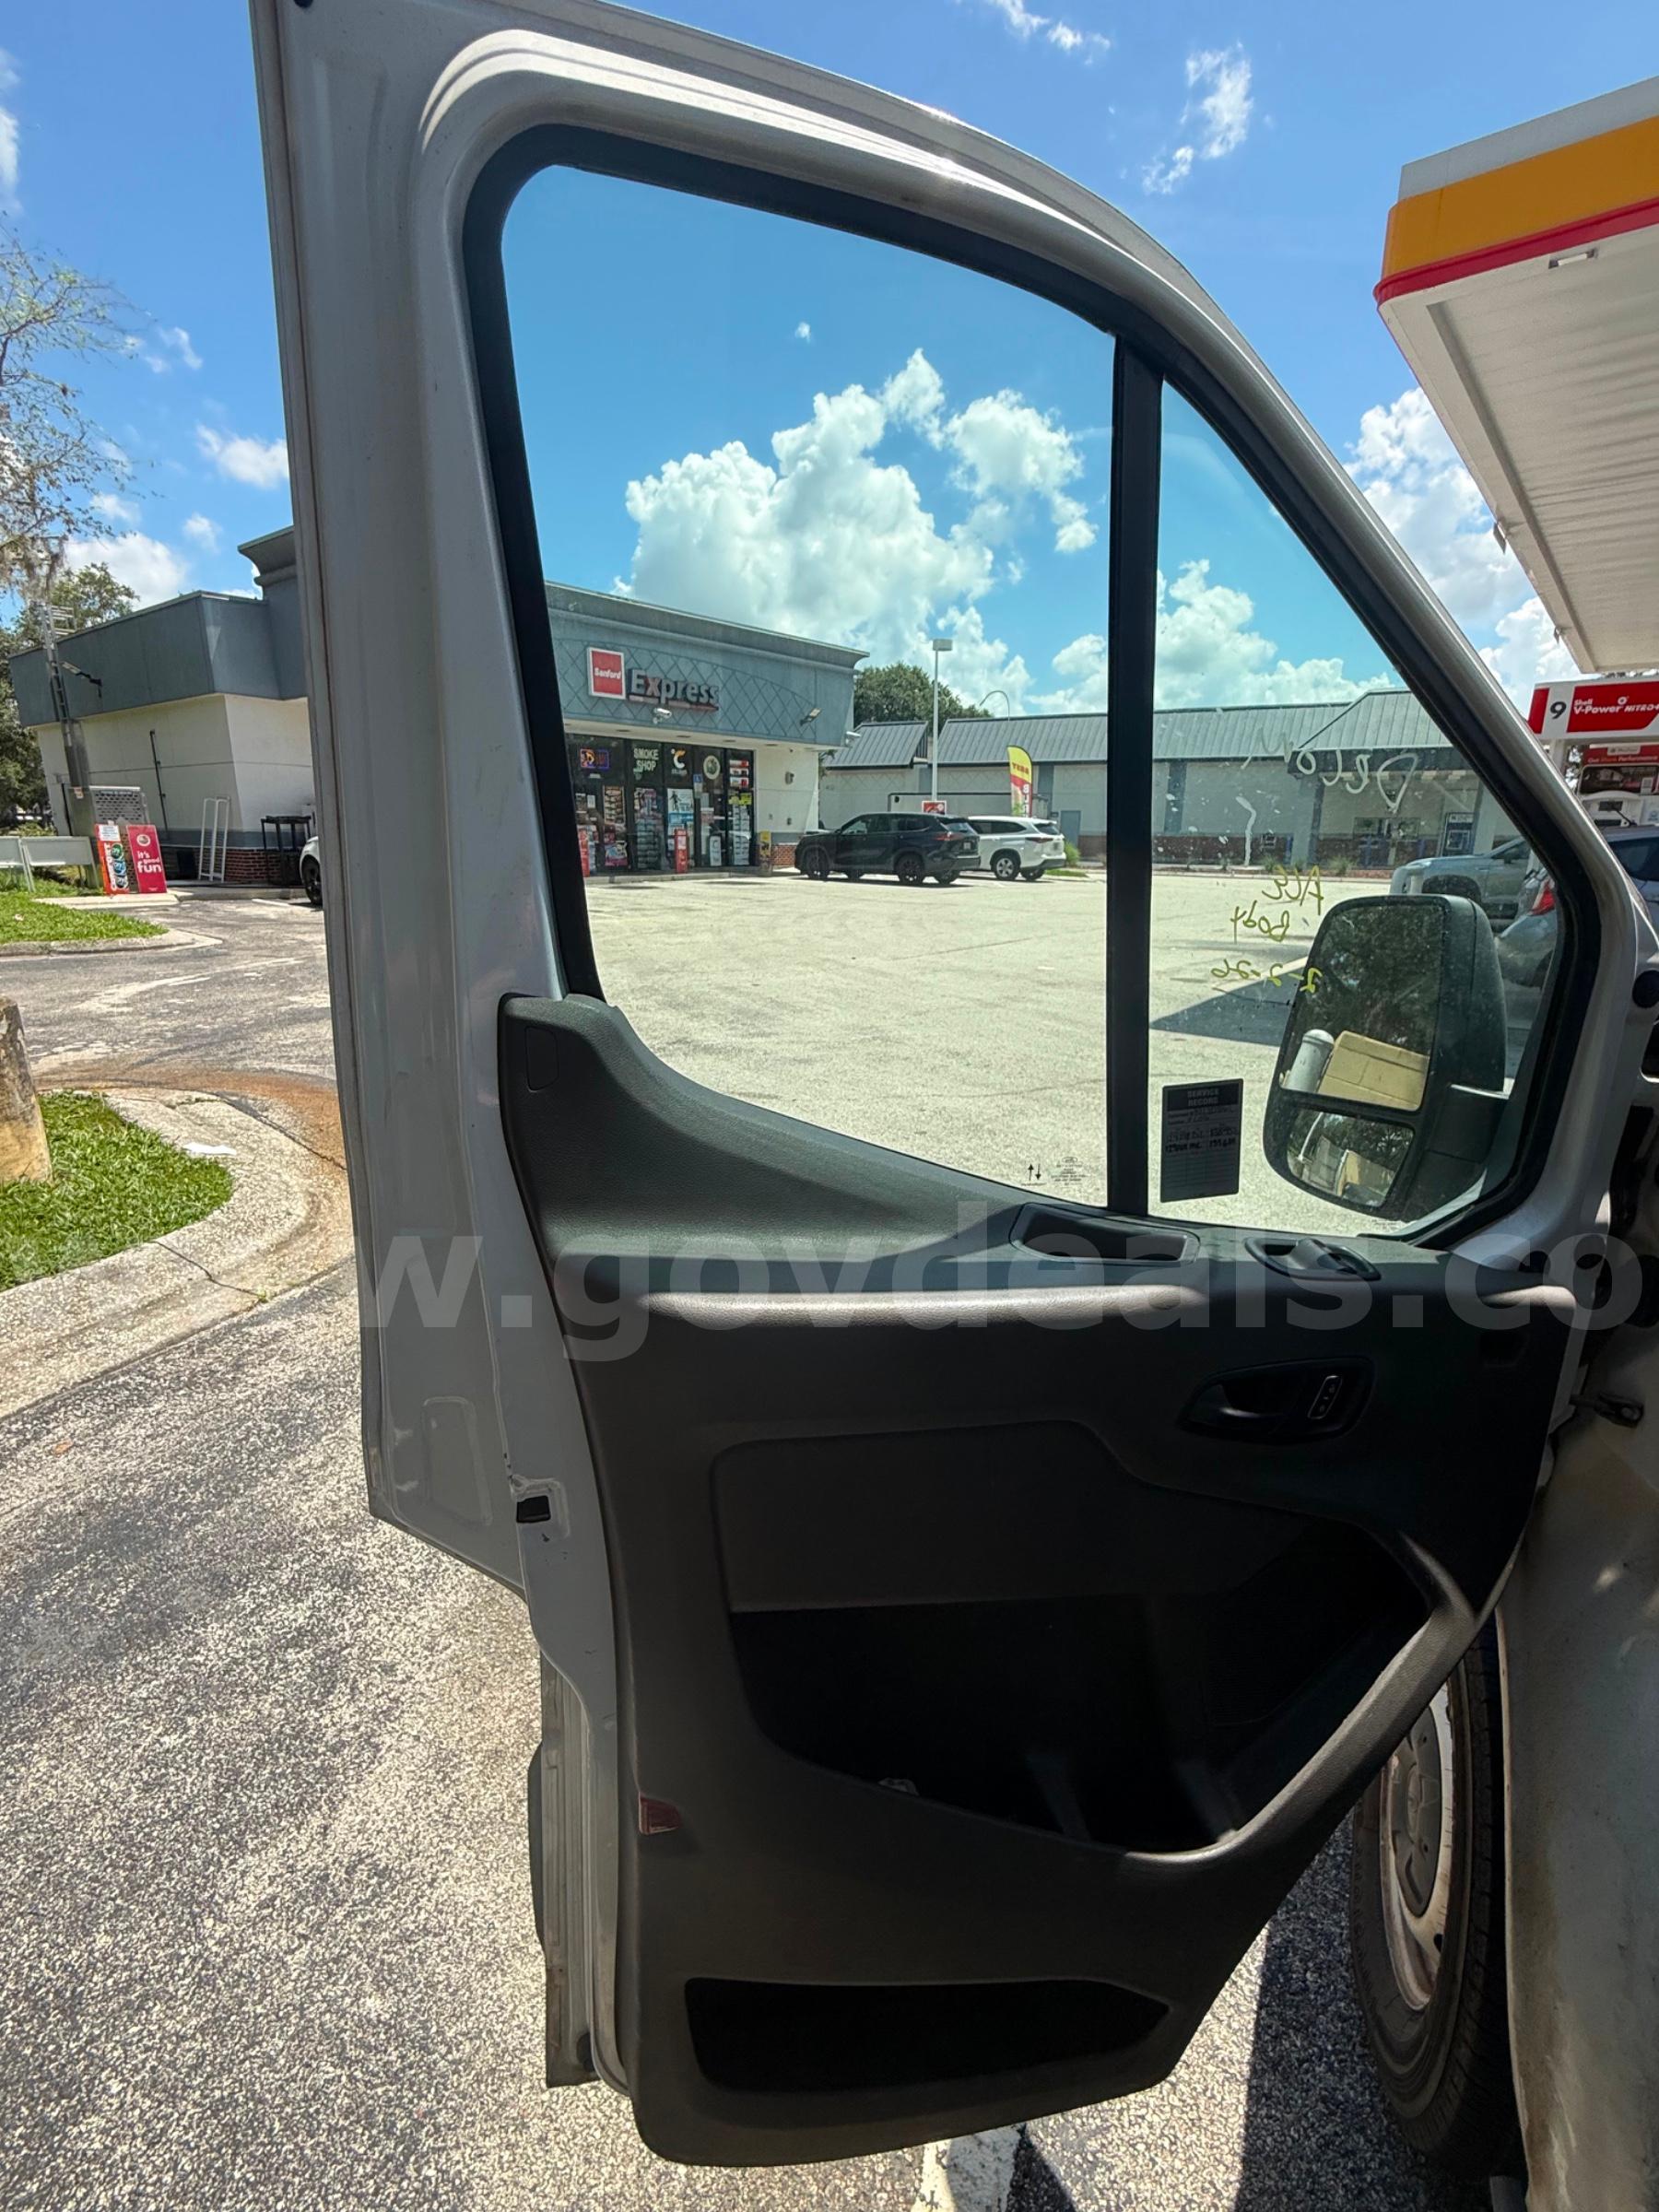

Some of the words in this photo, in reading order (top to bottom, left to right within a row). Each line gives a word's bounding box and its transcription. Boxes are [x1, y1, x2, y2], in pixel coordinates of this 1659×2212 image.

[594, 667, 622, 680] Sanford
[632, 668, 719, 705] Express
[1573, 698, 1594, 706] Shell
[1549, 700, 1567, 720] 9
[633, 747, 660, 760] SMOKE
[636, 759, 657, 772] SHOP
[136, 861, 162, 874] fun
